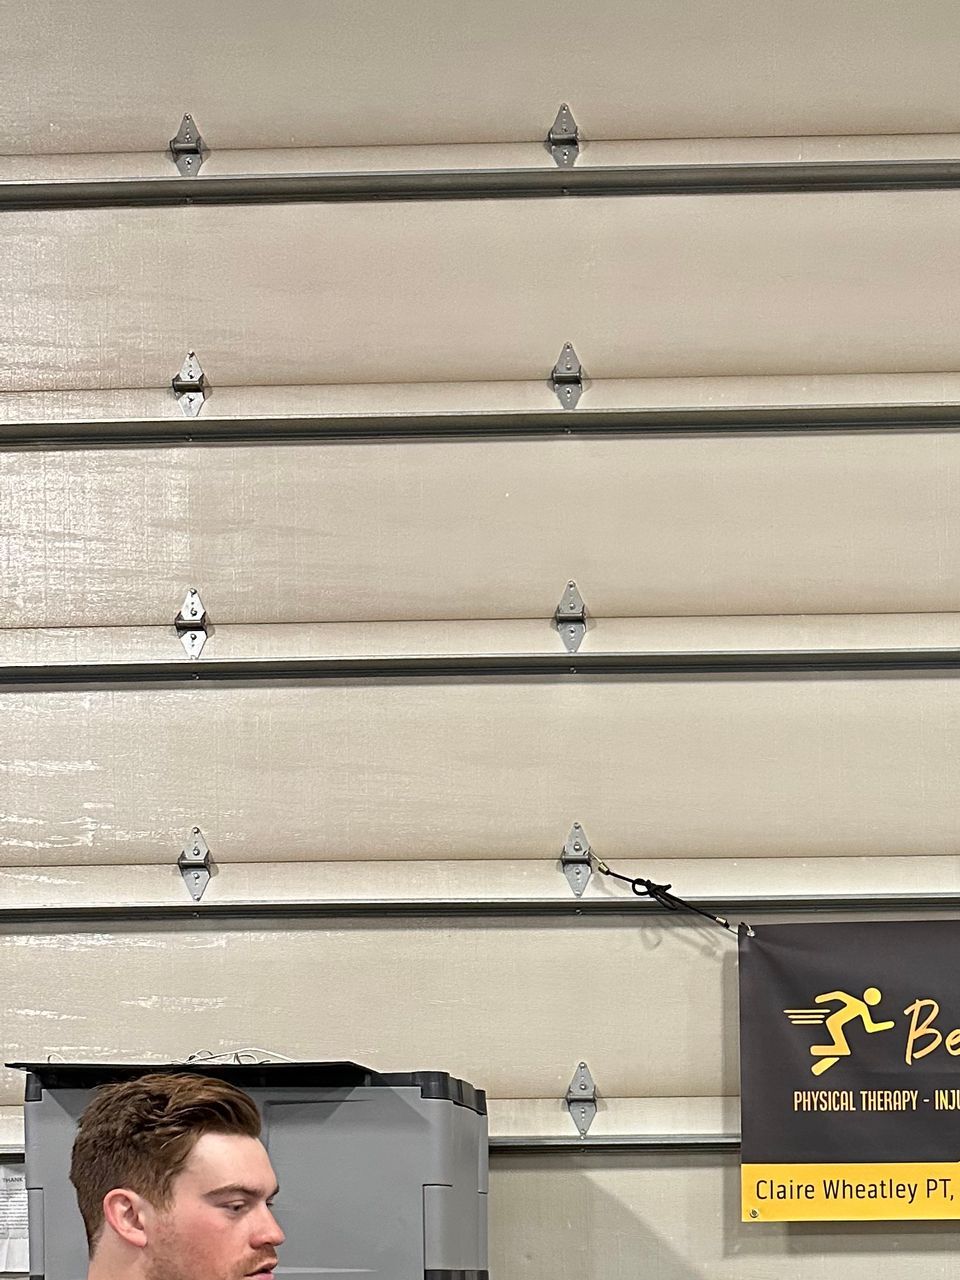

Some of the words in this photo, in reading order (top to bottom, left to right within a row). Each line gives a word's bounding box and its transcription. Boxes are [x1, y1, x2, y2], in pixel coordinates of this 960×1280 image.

[793, 1090, 857, 1112] PHYSICAL
[859, 1090, 919, 1111] THERAPY
[755, 1179, 815, 1200] Claire
[822, 1178, 918, 1204] Wheatley
[926, 1178, 954, 1201] PT,
